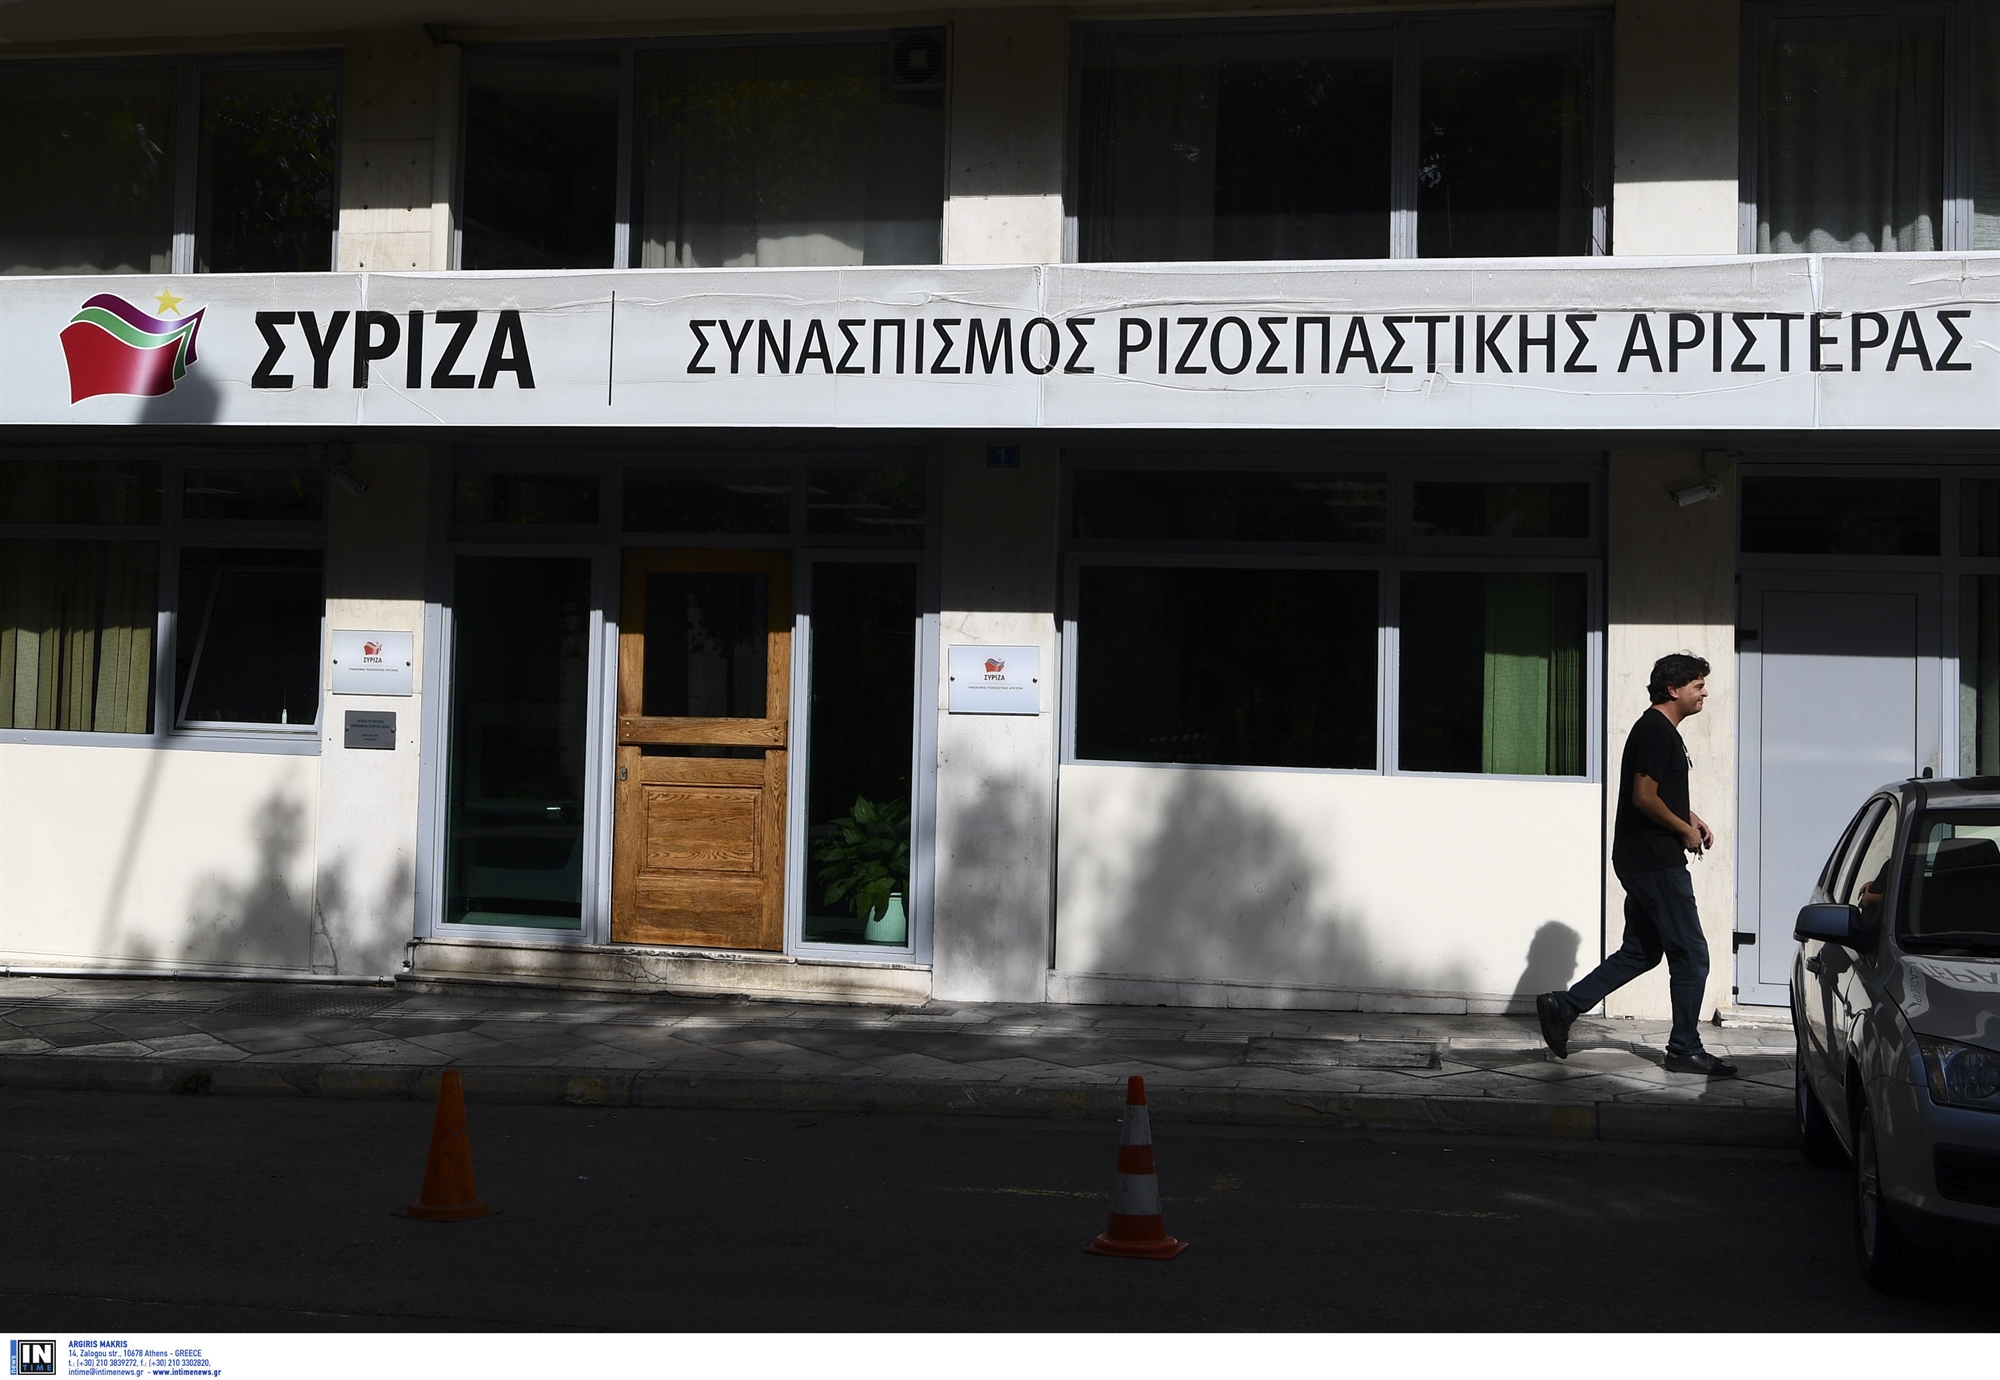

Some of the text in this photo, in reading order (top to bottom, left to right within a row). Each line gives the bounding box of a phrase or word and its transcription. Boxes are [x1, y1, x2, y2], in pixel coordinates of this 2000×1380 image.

[252, 308, 536, 389] ΣΥΡΙΖΑ
[686, 310, 1972, 375] ΣΥΝΑΣΠΙΣΜΟΣ ΡΙΖΟΣΠΑΣΤΙΚΗΣ ΑΡΙΣΤΕΡΑΣ
[998, 448, 1005, 463] 1
[363, 656, 382, 664] ΣΥΡΙΖΑ
